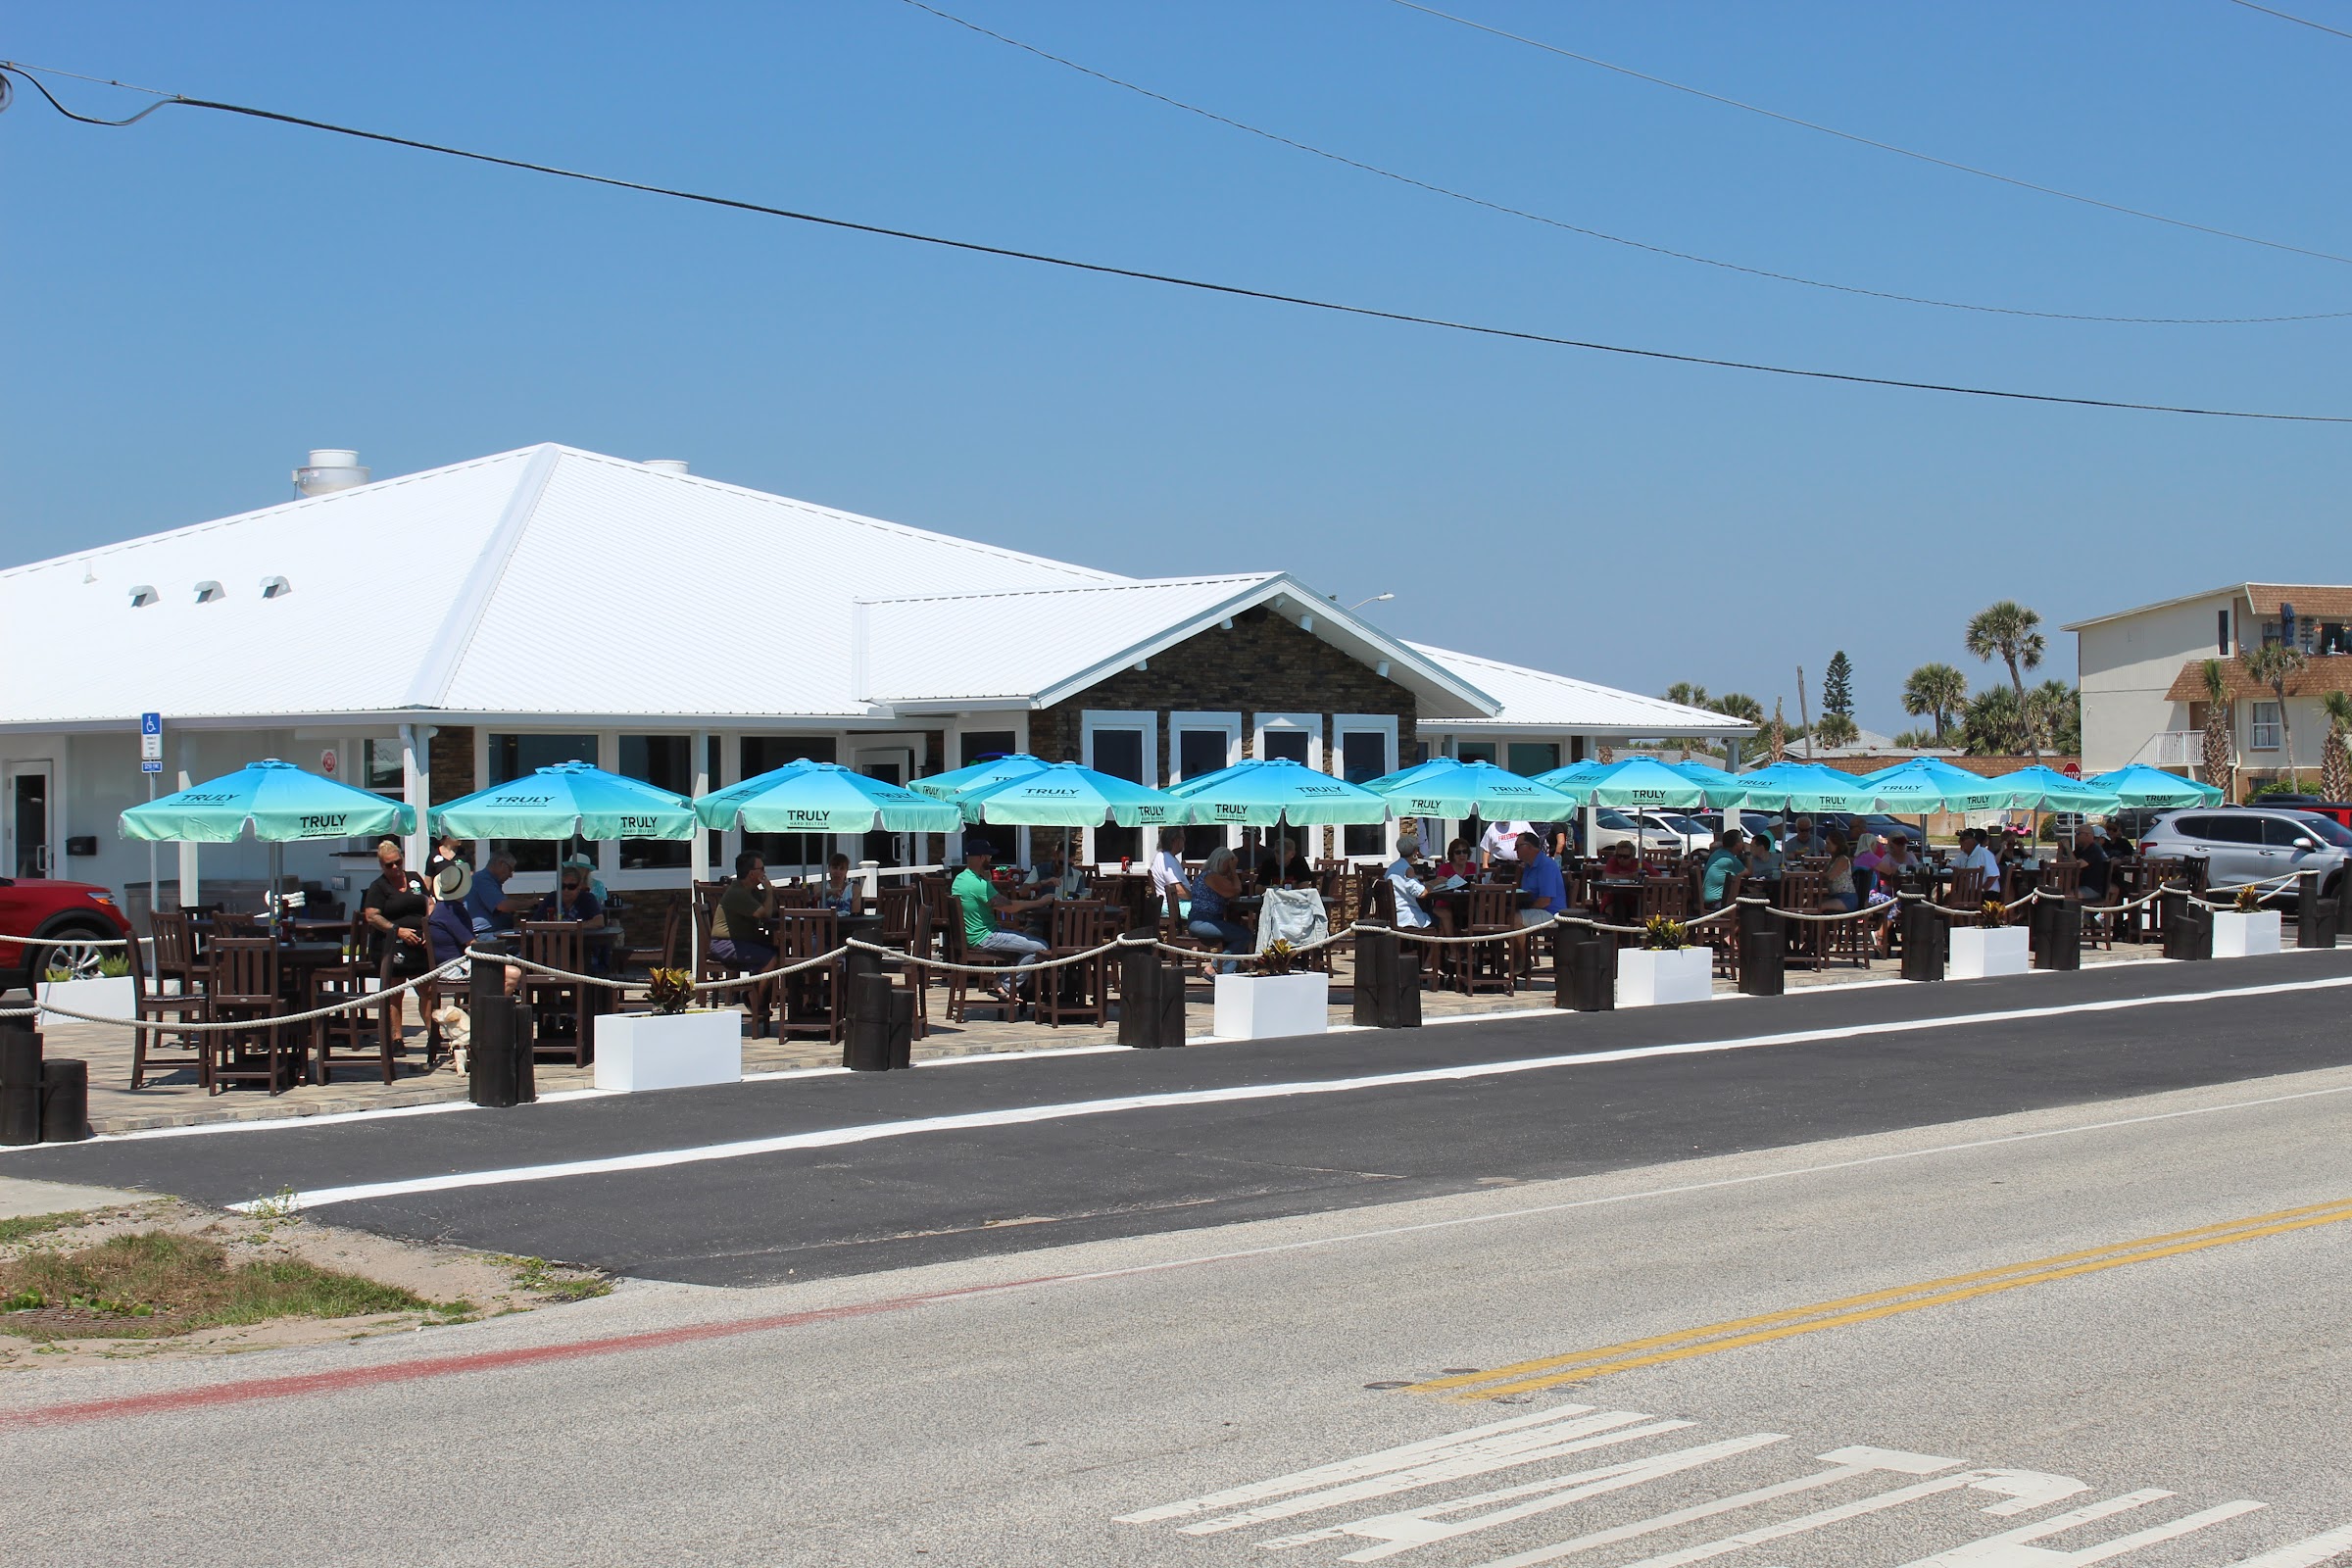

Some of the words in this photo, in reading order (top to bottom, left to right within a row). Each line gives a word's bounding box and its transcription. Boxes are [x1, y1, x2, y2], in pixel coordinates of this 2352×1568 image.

[922, 785, 941, 795] TRULY
[1631, 790, 1667, 799] TRULY
[1410, 799, 1443, 809] TRULY
[1818, 796, 1847, 805] TRULY
[1966, 795, 1990, 805] TRULY
[1137, 806, 1165, 816] TRULY
[1214, 804, 1249, 814] TRULY
[786, 809, 831, 821] TRULY
[299, 813, 348, 829] TRULY
[619, 816, 658, 828] TRULY
